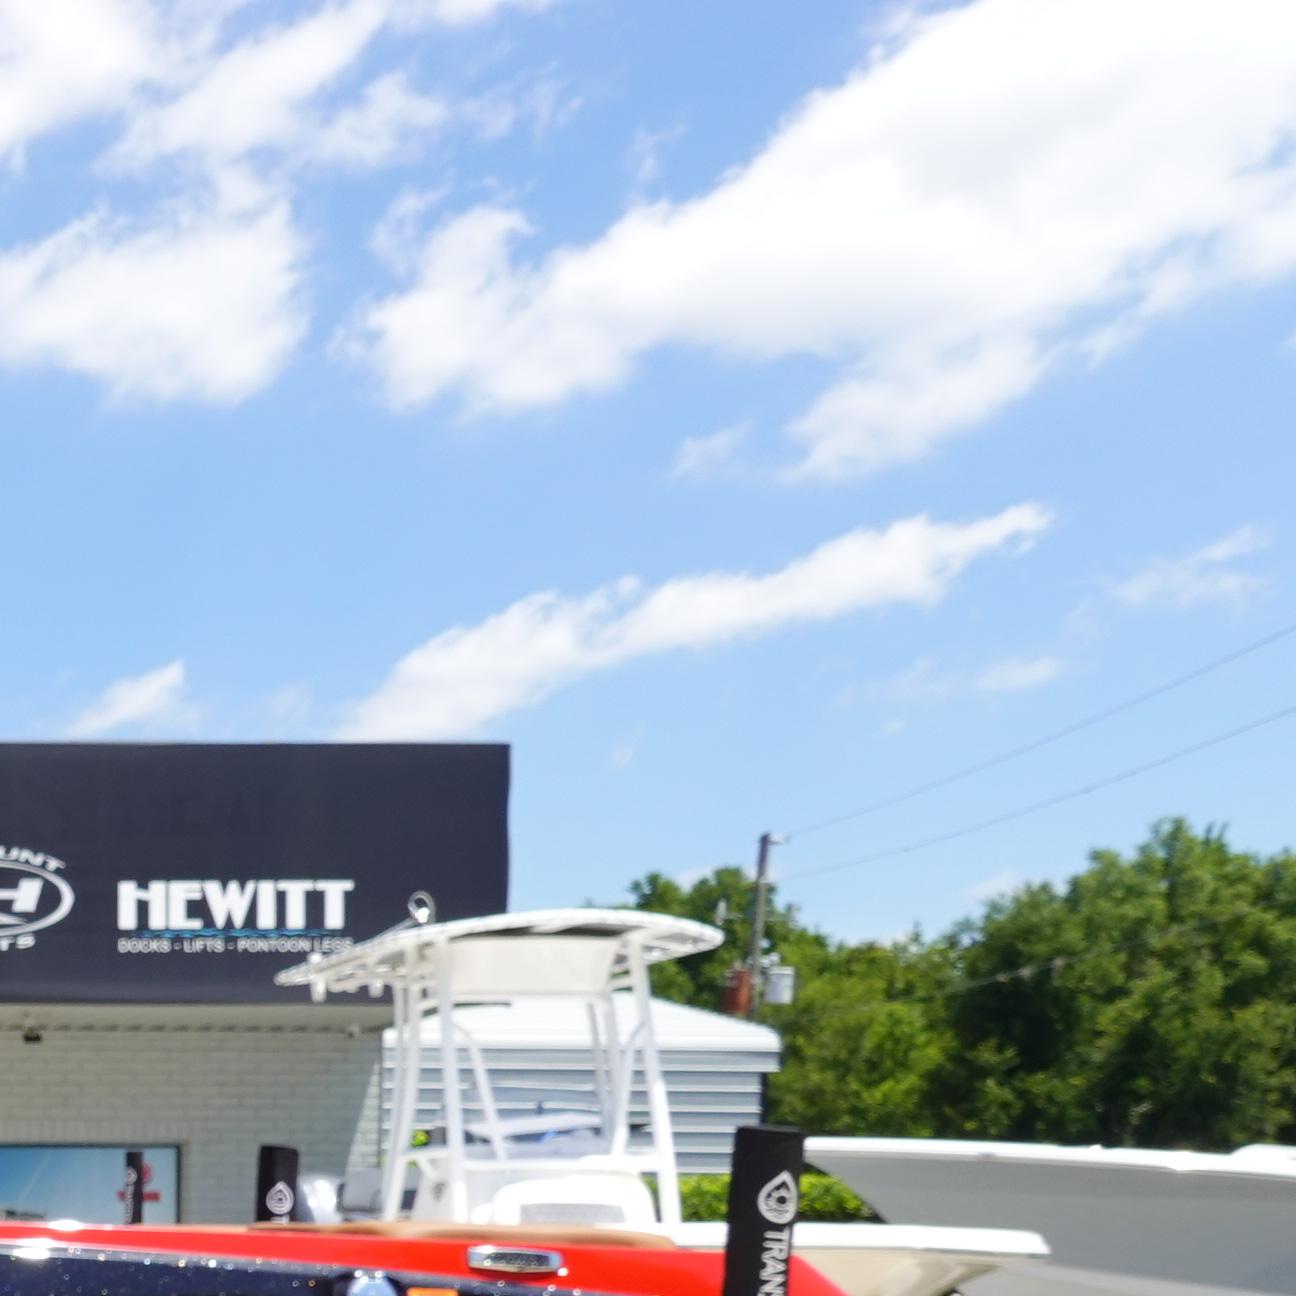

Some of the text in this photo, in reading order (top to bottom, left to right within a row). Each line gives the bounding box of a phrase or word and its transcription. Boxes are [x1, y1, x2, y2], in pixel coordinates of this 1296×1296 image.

[117, 879, 355, 930] HEWITT
[117, 937, 171, 953] DOCKS
[183, 937, 225, 953] LIFTS
[237, 937, 310, 953] PONTOON
